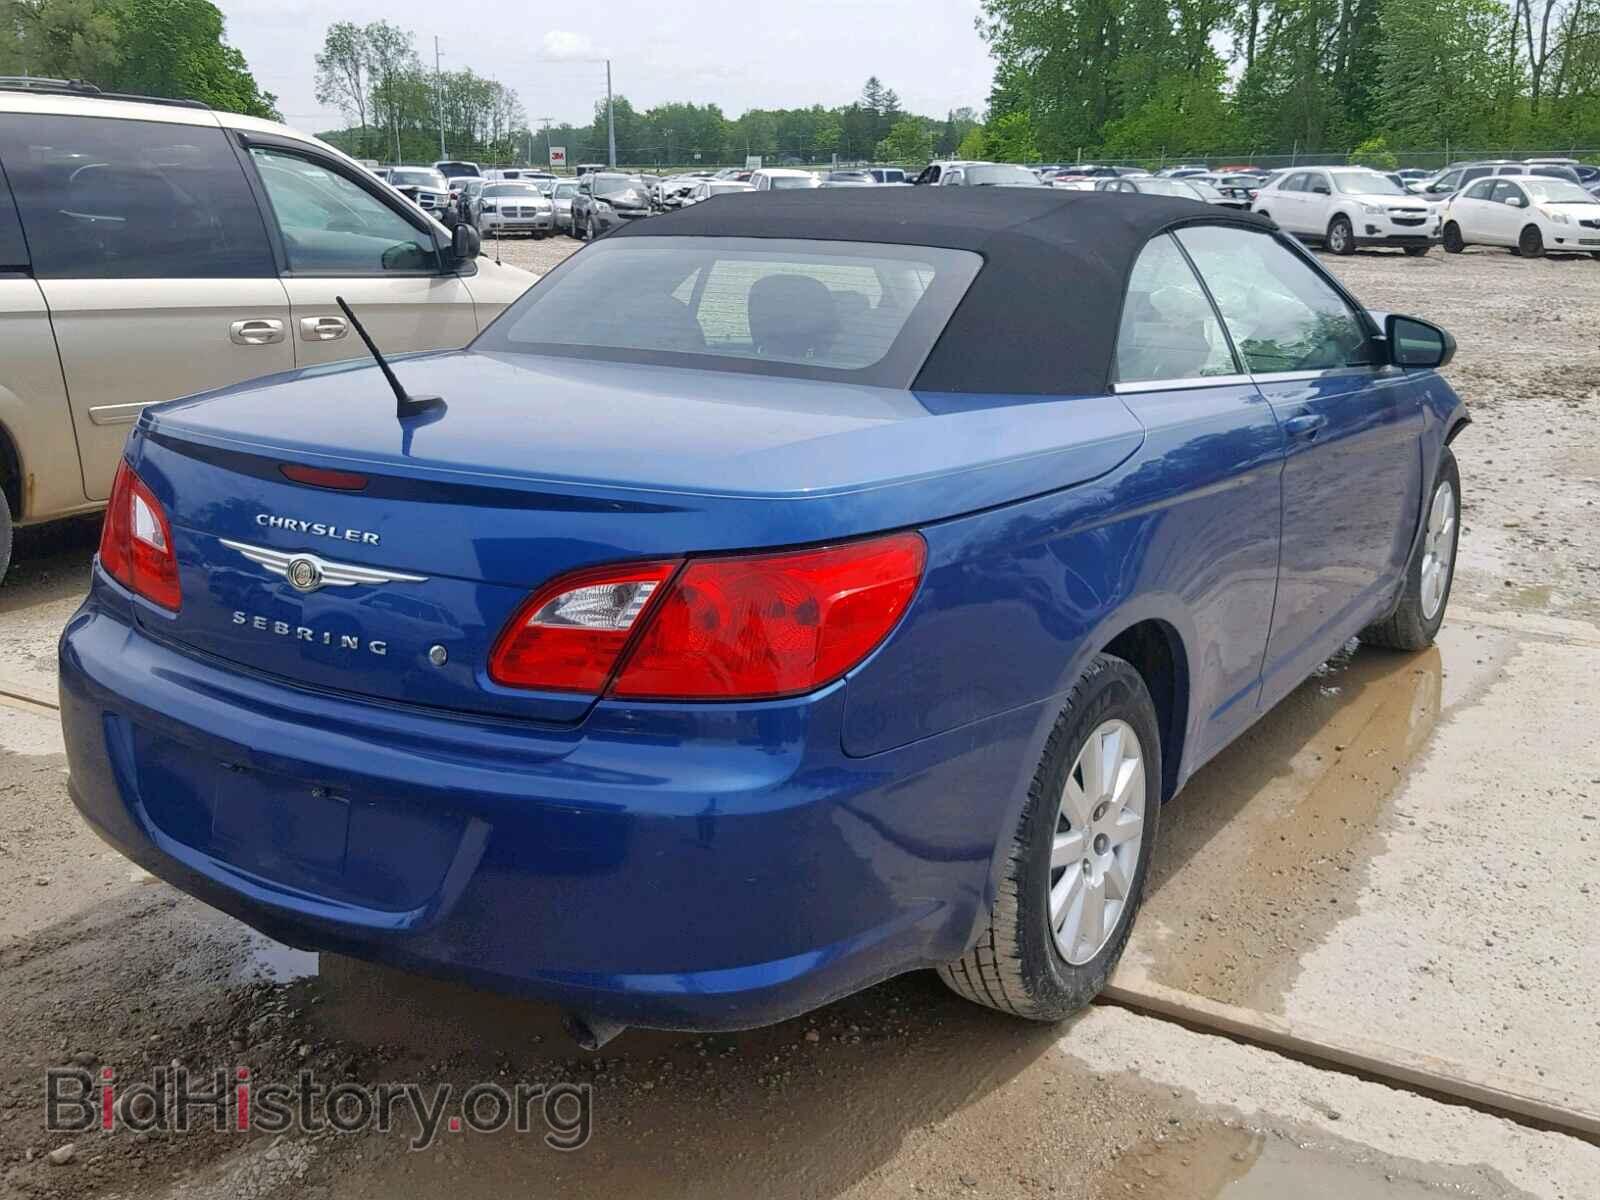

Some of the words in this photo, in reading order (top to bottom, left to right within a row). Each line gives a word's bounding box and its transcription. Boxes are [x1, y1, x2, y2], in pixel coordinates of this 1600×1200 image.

[551, 152, 565, 160] 3M
[255, 514, 381, 545] CHRYSLER
[232, 611, 388, 655] SEBRING
